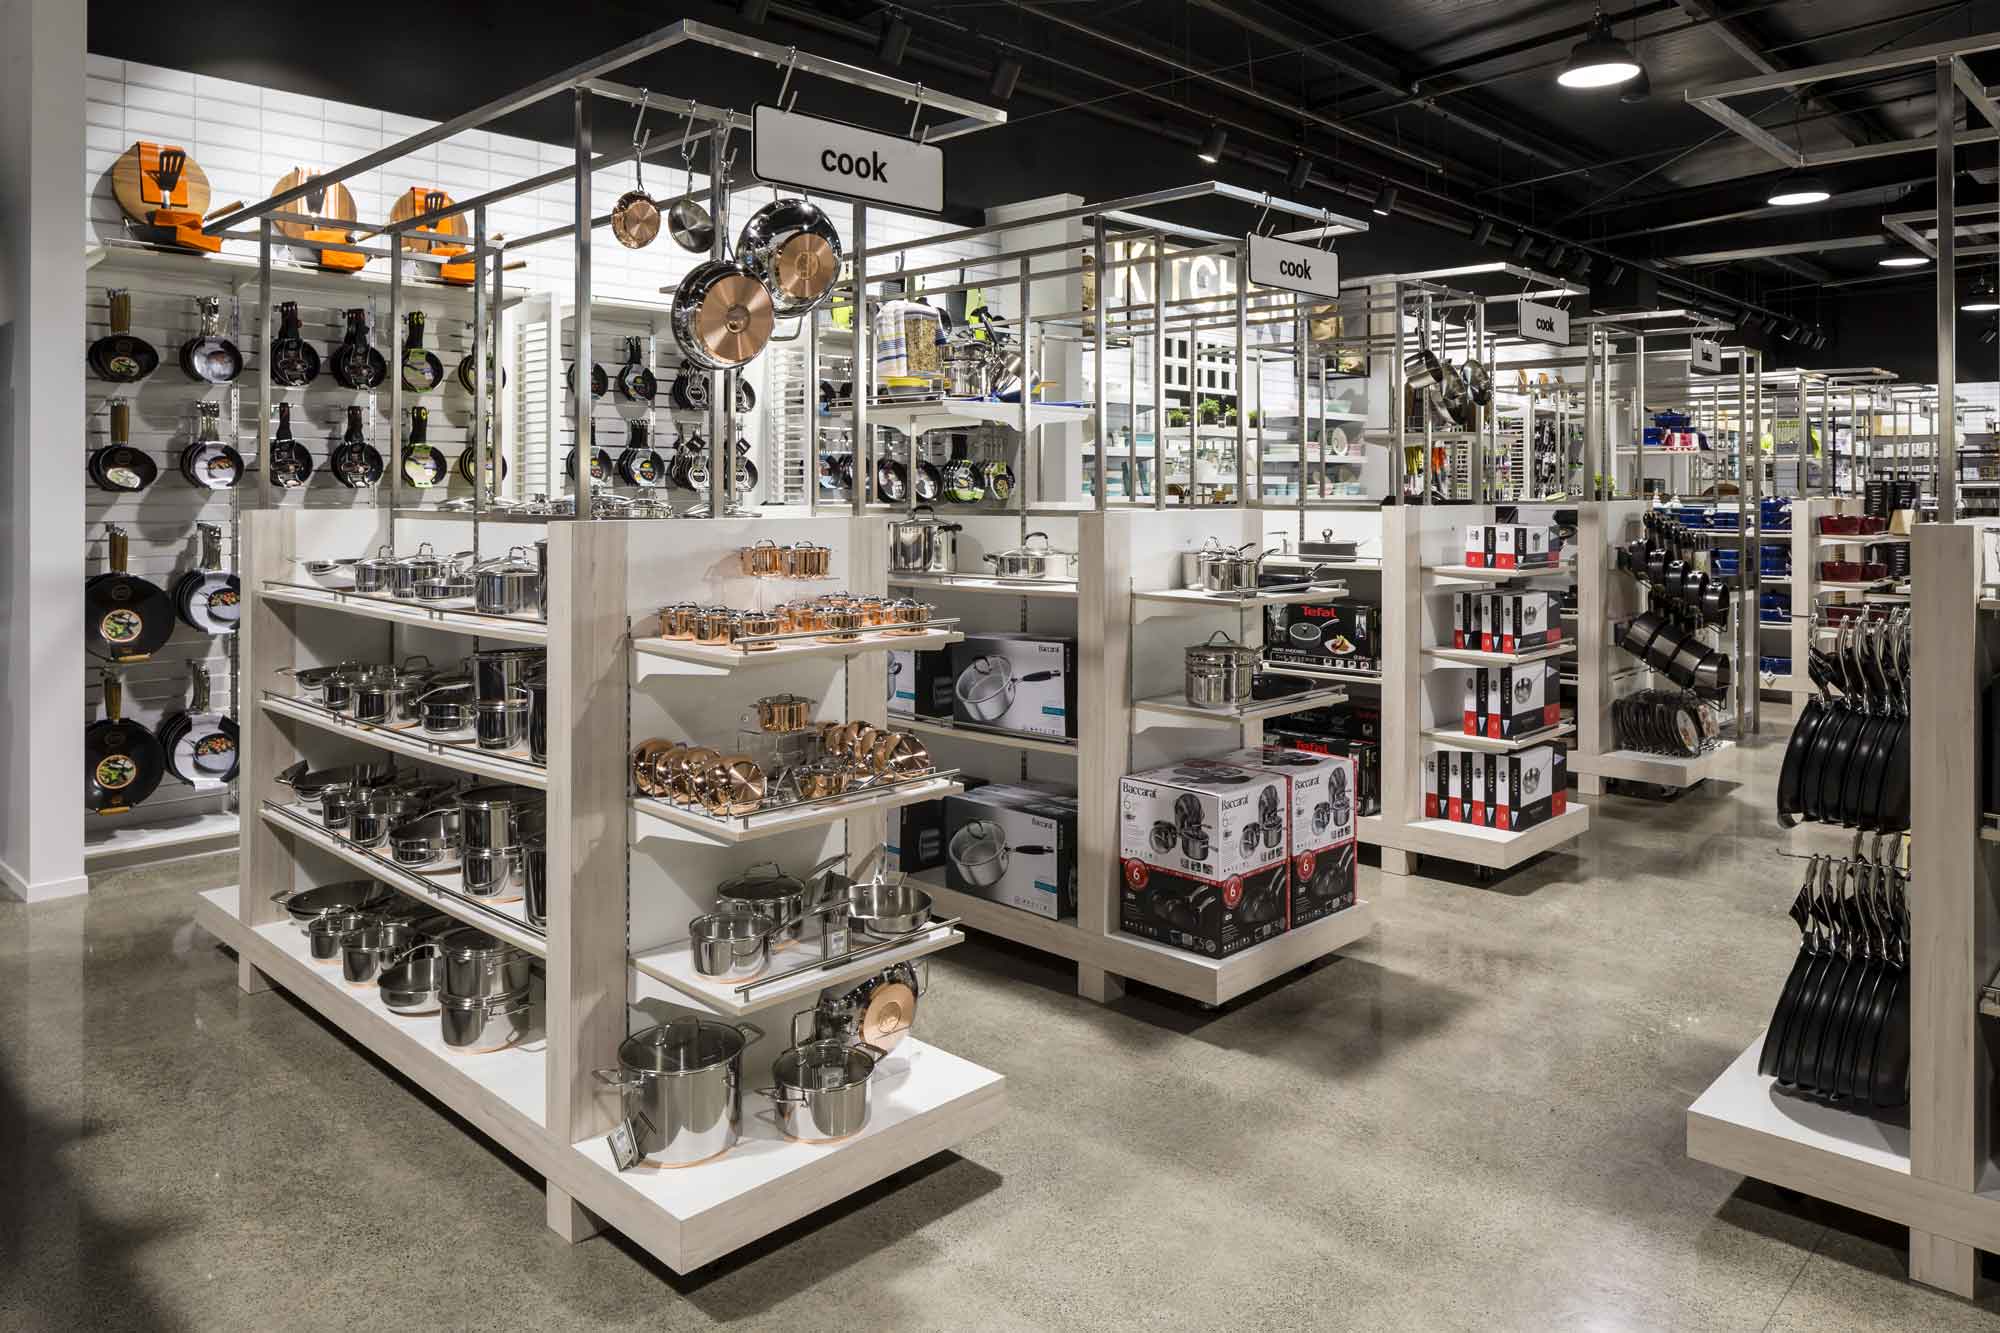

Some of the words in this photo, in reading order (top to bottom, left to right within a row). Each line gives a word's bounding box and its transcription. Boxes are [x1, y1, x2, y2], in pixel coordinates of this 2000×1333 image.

[820, 149, 889, 184] cook
[1279, 258, 1312, 281] cook
[1535, 316, 1555, 333] cook
[1300, 604, 1337, 618] Tefal
[1122, 782, 1158, 799] Baccarat
[1303, 859, 1309, 872] 6
[1132, 868, 1141, 881] 6
[1229, 884, 1236, 897] 6
